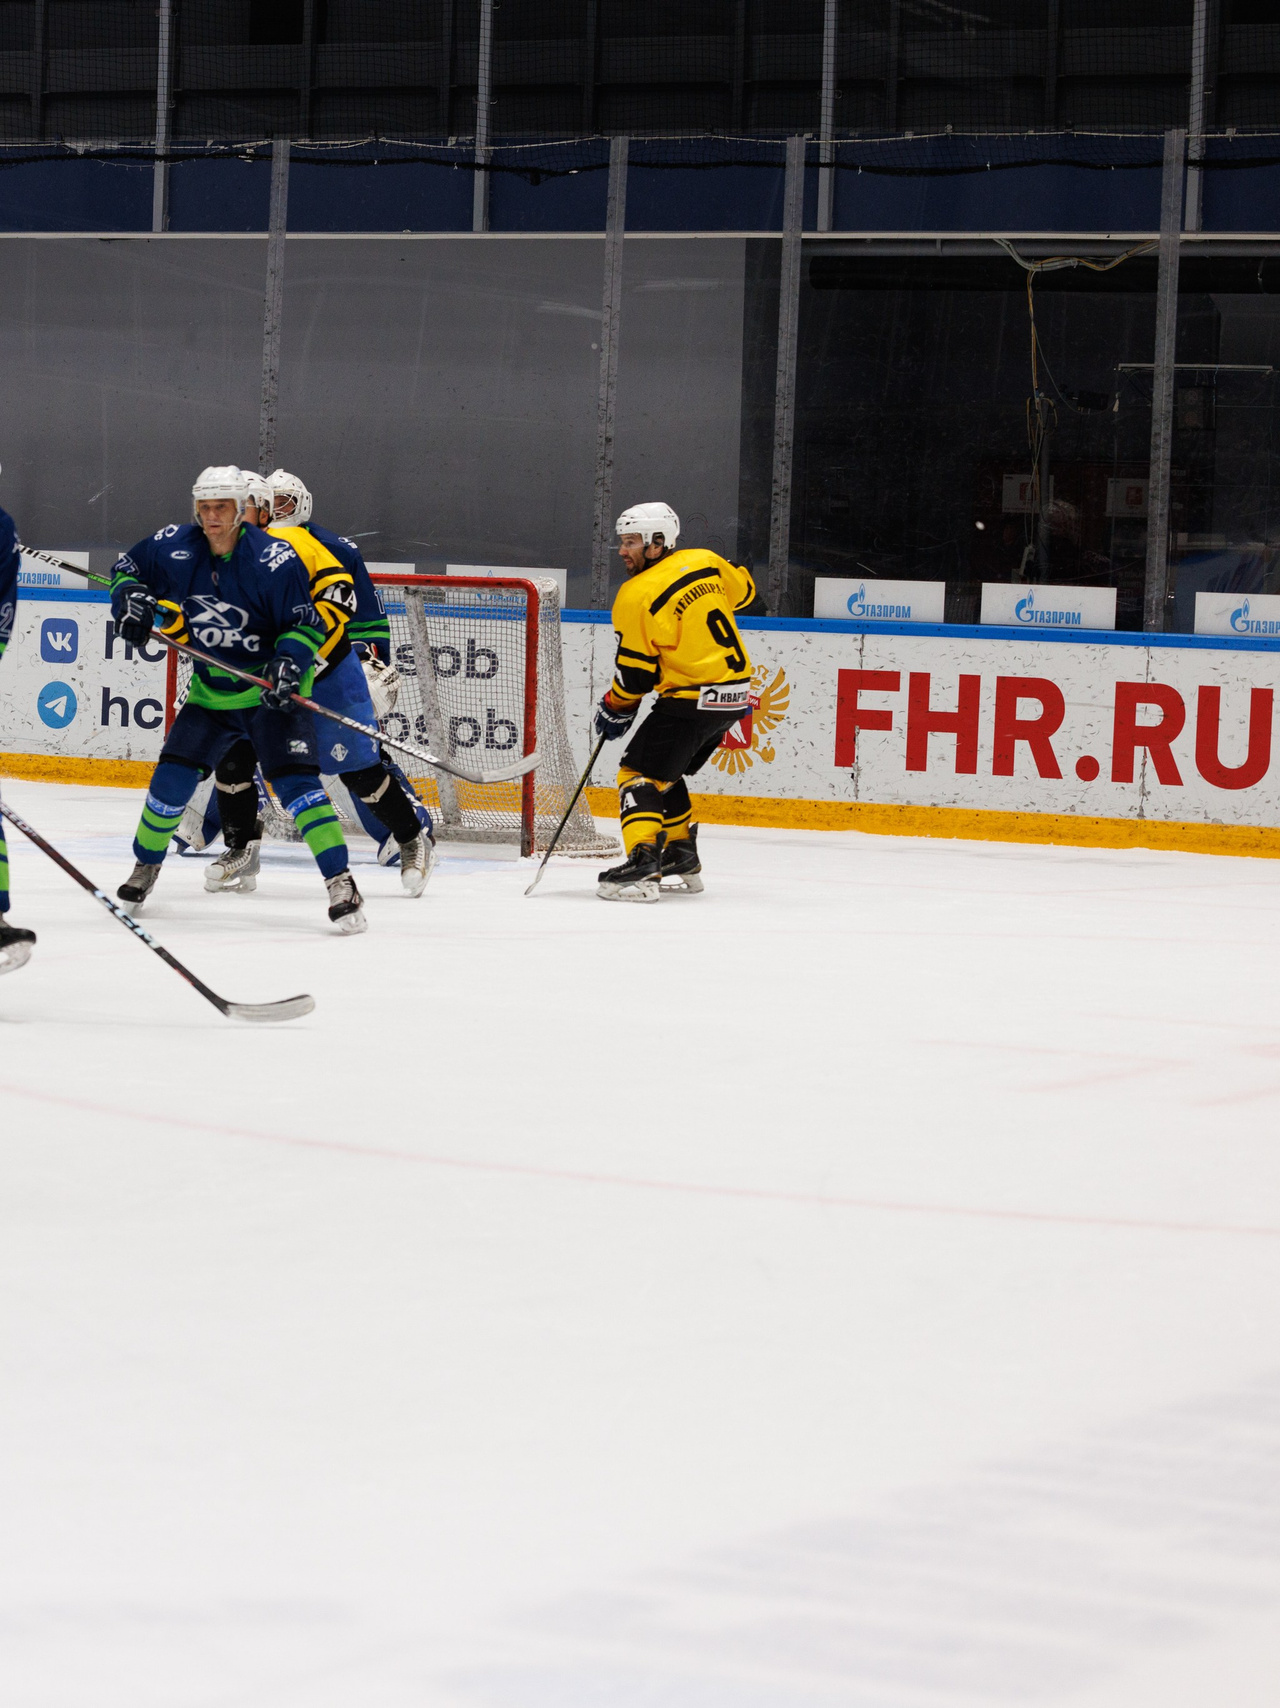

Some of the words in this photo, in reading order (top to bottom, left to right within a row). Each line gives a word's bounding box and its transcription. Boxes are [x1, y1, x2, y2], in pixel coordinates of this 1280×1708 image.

[268, 549, 297, 572] ХОРС
[22, 572, 61, 586] ГАЗПРОМ
[866, 604, 911, 618] ГАЗПРОМ
[1034, 610, 1081, 625] ГАЗПРОМ
[706, 608, 747, 674] 9
[834, 668, 1274, 790] FHR.RU
